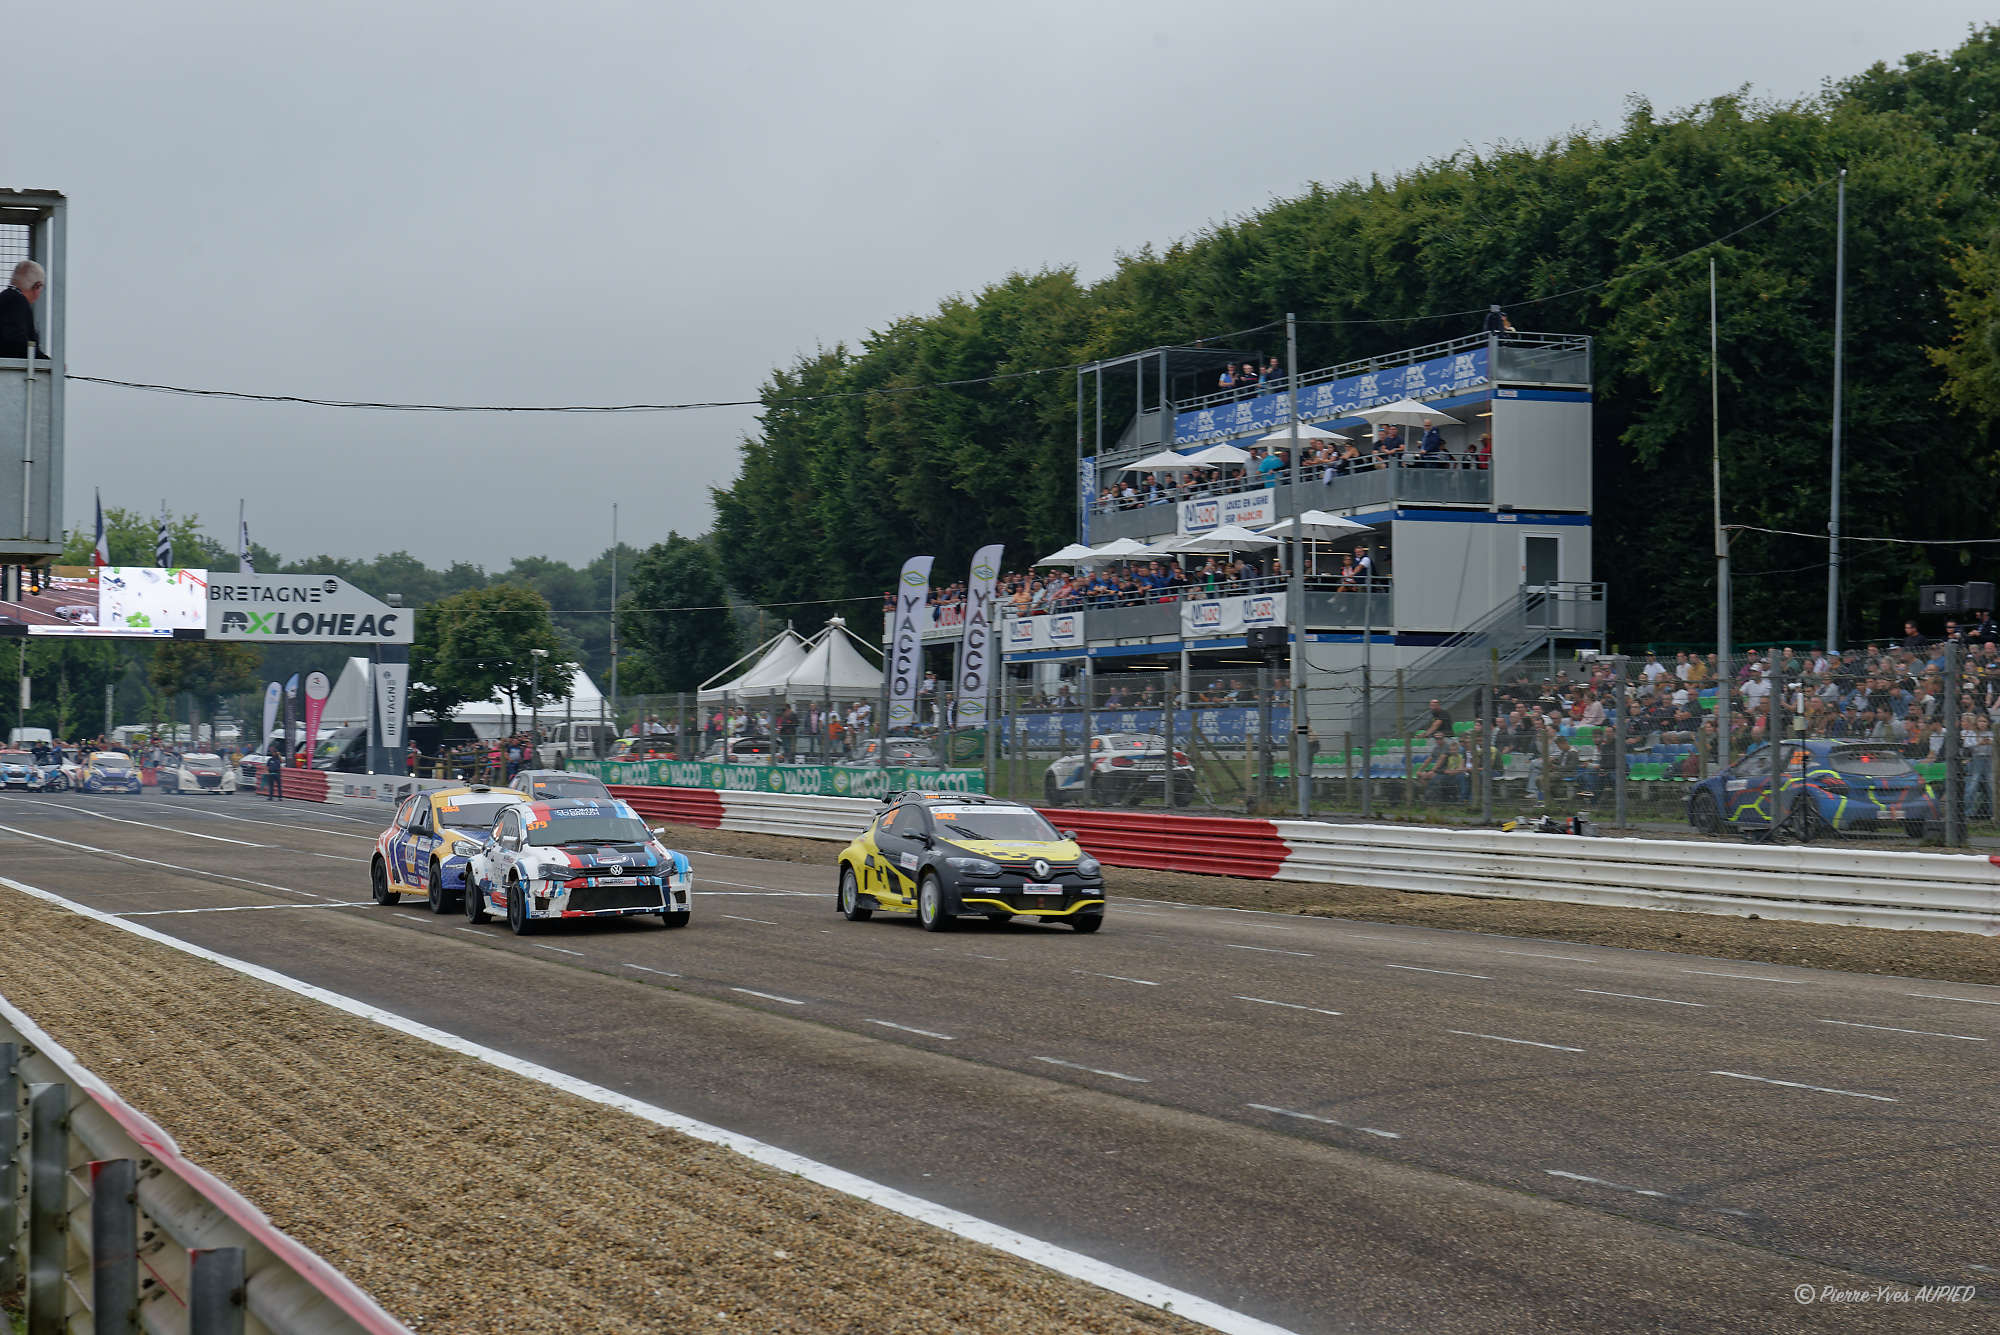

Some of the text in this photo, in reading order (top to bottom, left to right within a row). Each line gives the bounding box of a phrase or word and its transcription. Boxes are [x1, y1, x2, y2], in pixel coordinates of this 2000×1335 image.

[210, 585, 321, 602] BRETAGNE
[894, 595, 919, 696] YACCO
[963, 589, 991, 692] YACCO
[724, 767, 757, 790] YACCO
[783, 768, 821, 793] YACCO
[526, 820, 548, 831] 379
